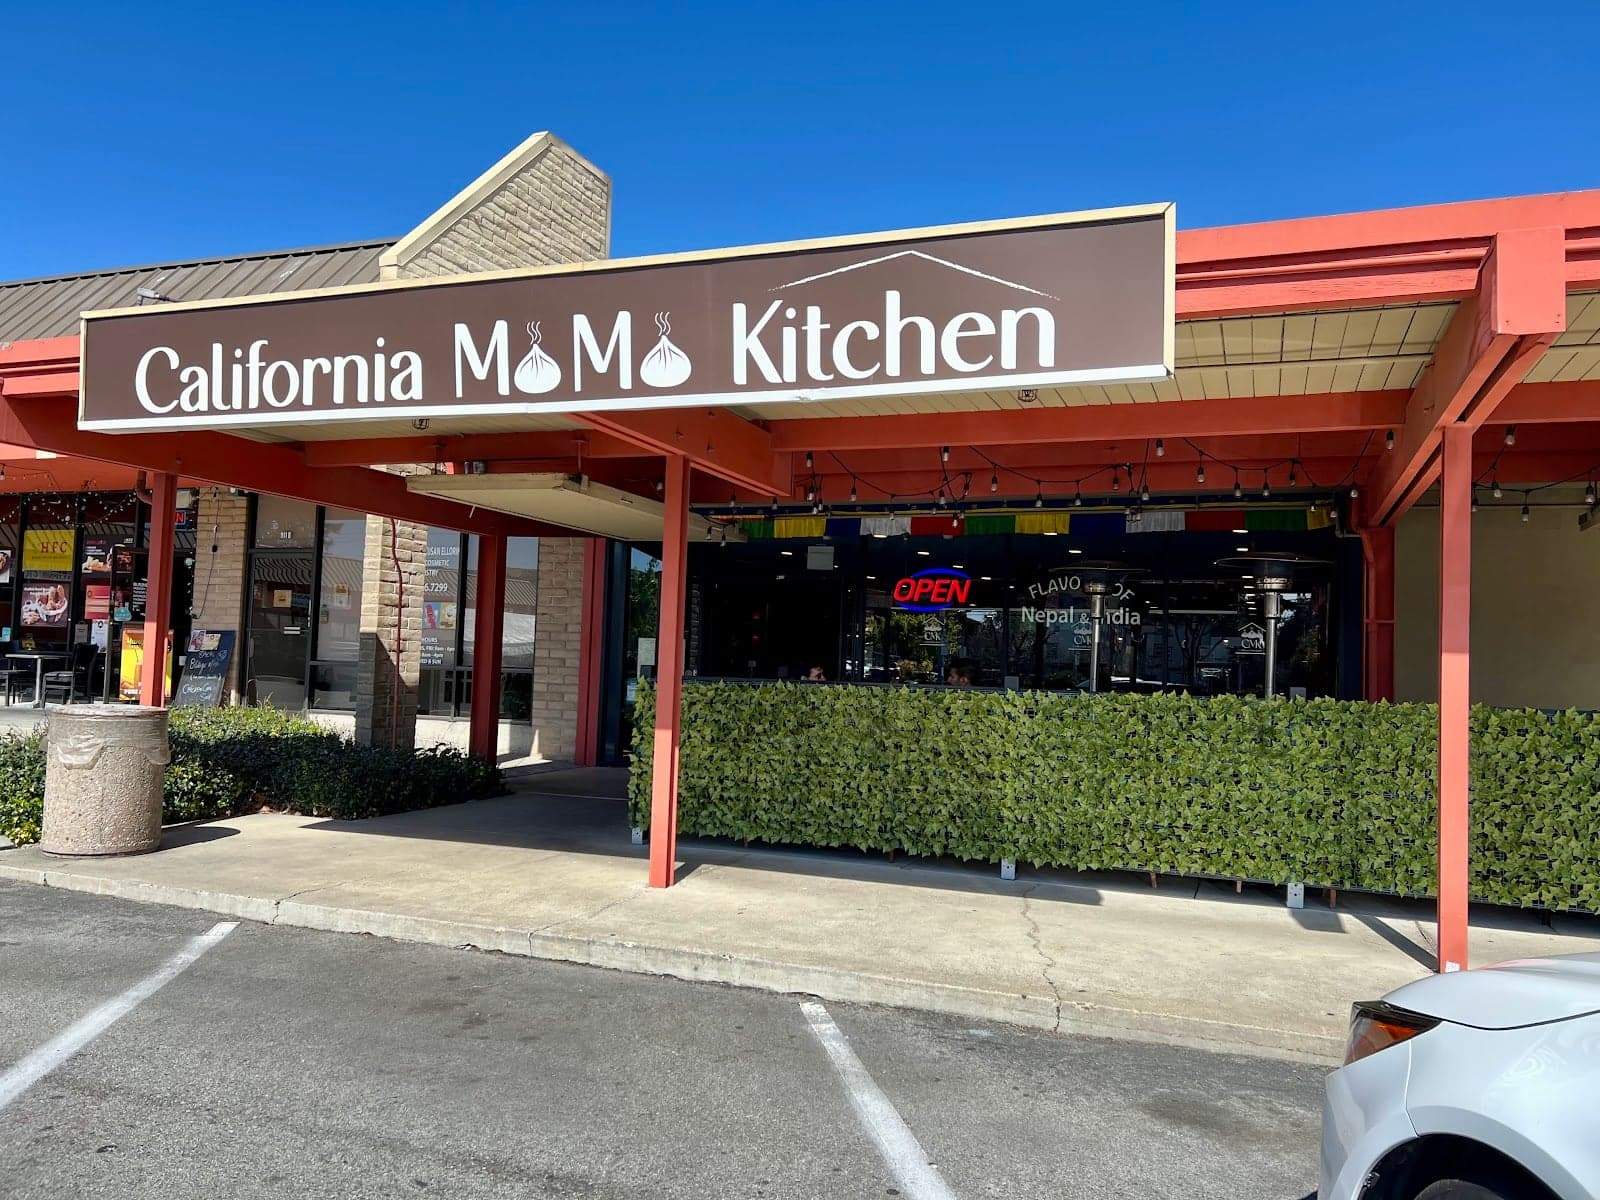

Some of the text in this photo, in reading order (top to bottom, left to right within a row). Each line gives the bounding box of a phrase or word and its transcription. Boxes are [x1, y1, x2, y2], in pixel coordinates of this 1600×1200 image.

[135, 337, 423, 414] California
[732, 289, 1056, 385] Kitchen
[894, 578, 971, 603] OPEN
[1028, 576, 1081, 600] FLAVO
[1021, 606, 1141, 628] Nepal & ndia
